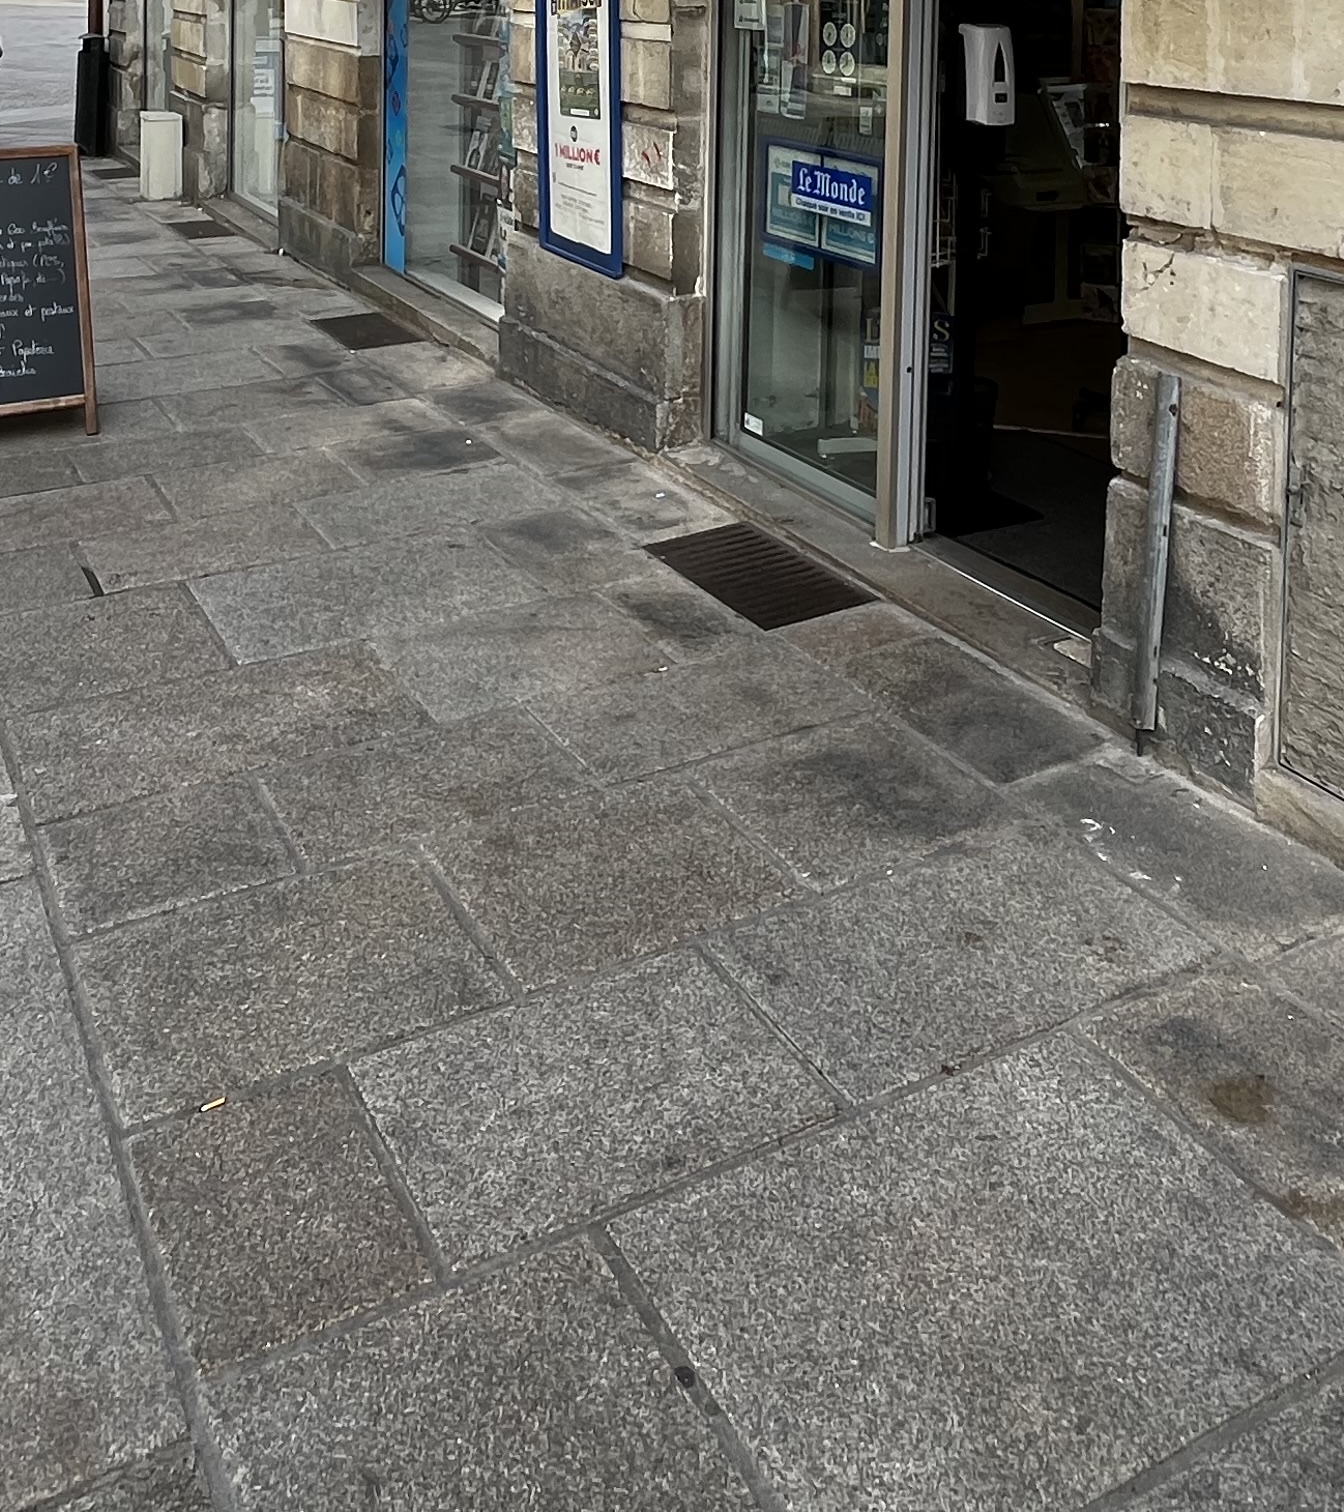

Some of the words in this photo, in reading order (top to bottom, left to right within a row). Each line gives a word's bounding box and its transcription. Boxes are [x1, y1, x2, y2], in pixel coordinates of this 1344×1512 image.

[559, 144, 593, 163] MILLION
[8, 168, 23, 185] de
[797, 167, 812, 193] Le
[812, 170, 866, 205] Monde
[838, 208, 855, 219] vente
[24, 304, 36, 317] et
[40, 301, 74, 322] postaux
